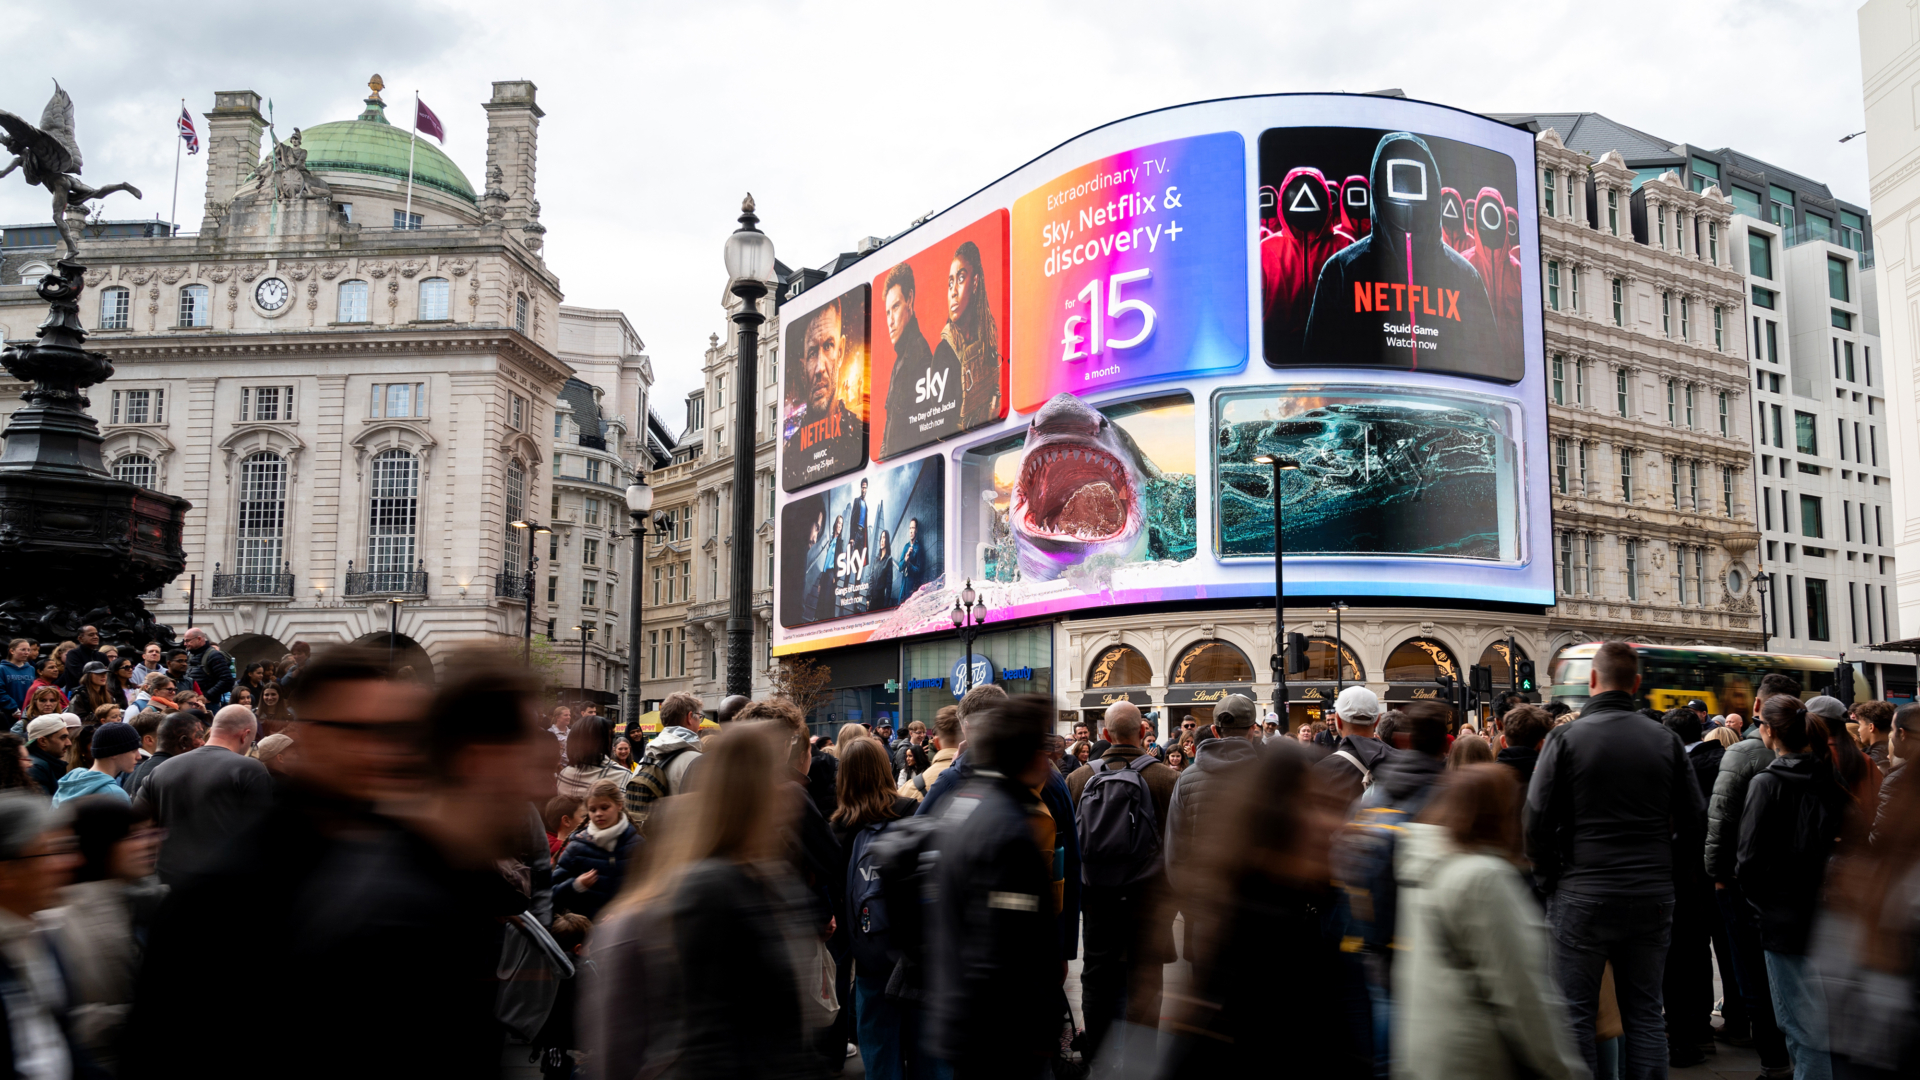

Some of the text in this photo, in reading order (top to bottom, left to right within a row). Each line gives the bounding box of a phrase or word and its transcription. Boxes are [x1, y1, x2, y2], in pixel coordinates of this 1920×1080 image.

[1047, 157, 1170, 211] Extraordinary TV.
[1043, 186, 1183, 247] Sky, Netflix &
[1044, 220, 1184, 278] discovery+
[1065, 299, 1076, 310] for
[1354, 281, 1461, 322] NETFLIX
[1061, 267, 1158, 362] £15
[1383, 322, 1439, 337] Squid Game
[1386, 336, 1438, 350] Watch now
[1084, 363, 1121, 381] a month
[915, 366, 949, 404] sky
[908, 399, 956, 425] The Day of the Jackal
[800, 411, 842, 452] NETFLIX
[919, 418, 945, 432] Watch now
[837, 544, 867, 580] sky
[835, 587, 848, 597] Gangs
[853, 582, 869, 592] London
[840, 596, 864, 606] Watch now
[953, 661, 986, 696] Bots
[1003, 666, 1032, 681] beauty
[908, 677, 944, 692] pharmacy
[1191, 690, 1221, 701] Lindt
[1302, 688, 1322, 699] Lin
[859, 865, 882, 882] VA
